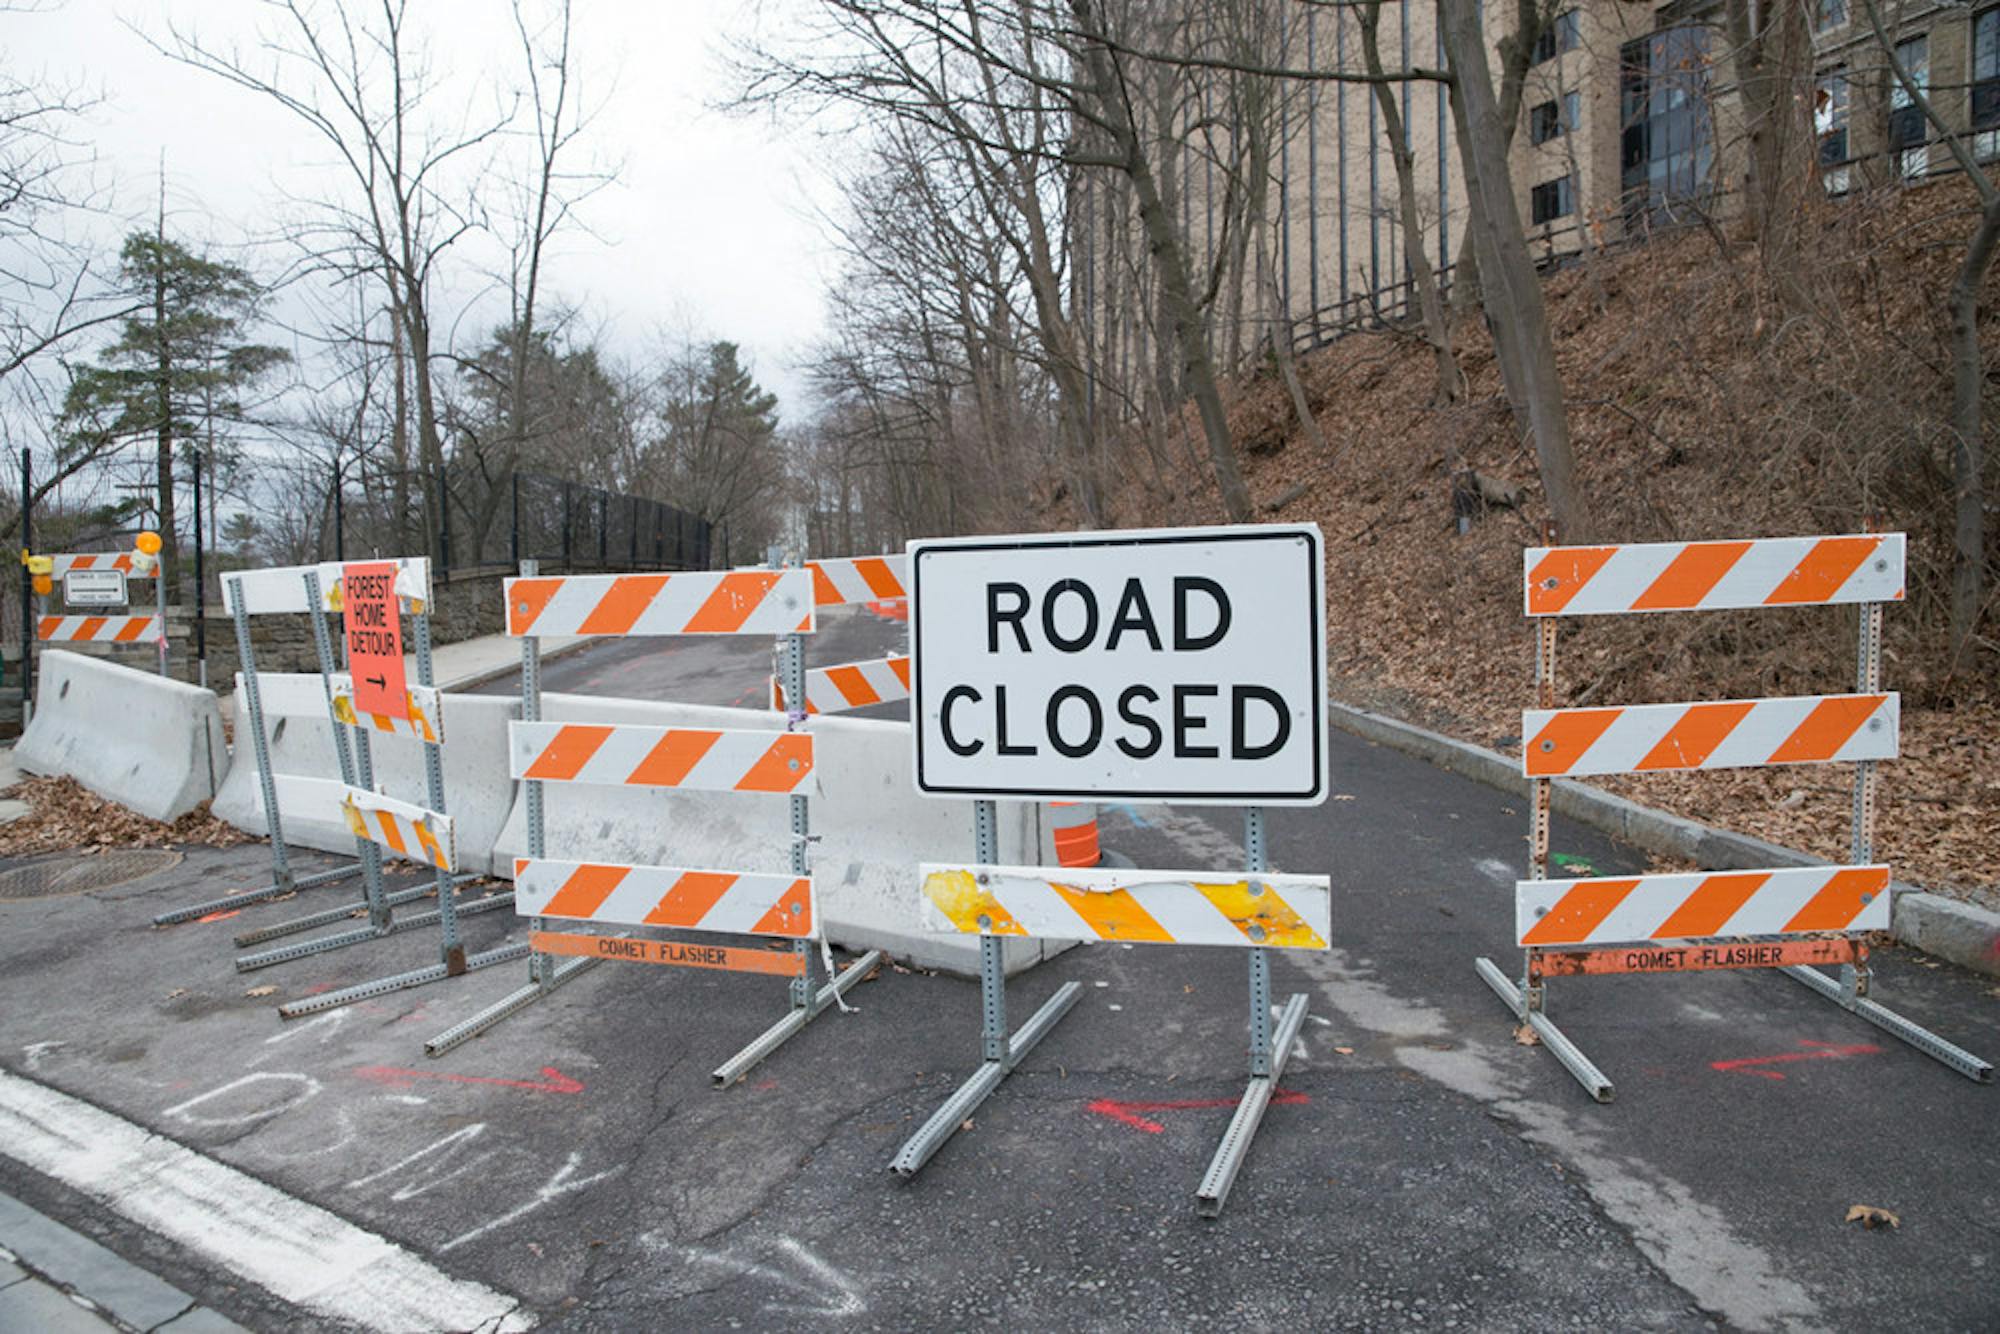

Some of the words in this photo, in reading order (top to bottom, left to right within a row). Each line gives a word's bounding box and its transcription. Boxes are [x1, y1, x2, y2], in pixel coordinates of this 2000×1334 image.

[346, 575, 391, 600] FOREST
[353, 602, 388, 627] HOME
[986, 575, 1233, 654] ROAD
[350, 630, 397, 657] DETOUR
[939, 683, 1292, 761] CLOSED
[598, 938, 647, 959] COMET
[659, 943, 728, 966] FLASHER
[1625, 950, 1687, 970] COMET
[1702, 946, 1784, 967] FLASHER
